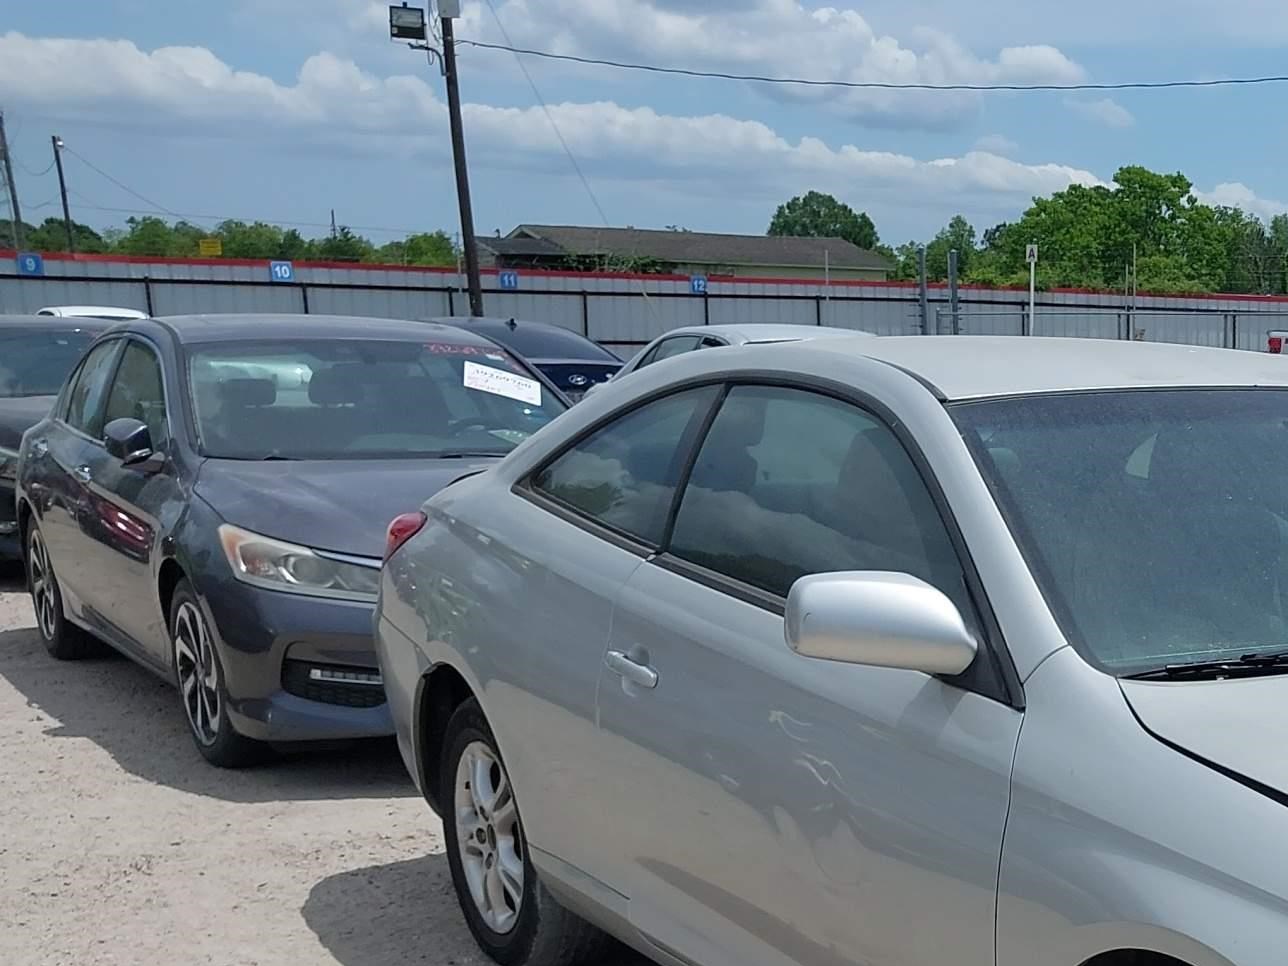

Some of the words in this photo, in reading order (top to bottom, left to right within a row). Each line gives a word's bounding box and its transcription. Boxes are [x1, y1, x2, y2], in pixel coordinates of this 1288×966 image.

[1028, 247, 1035, 258] A
[25, 257, 36, 271] 9
[274, 264, 290, 278] 10
[502, 273, 515, 287] 11
[693, 279, 705, 291] 12
